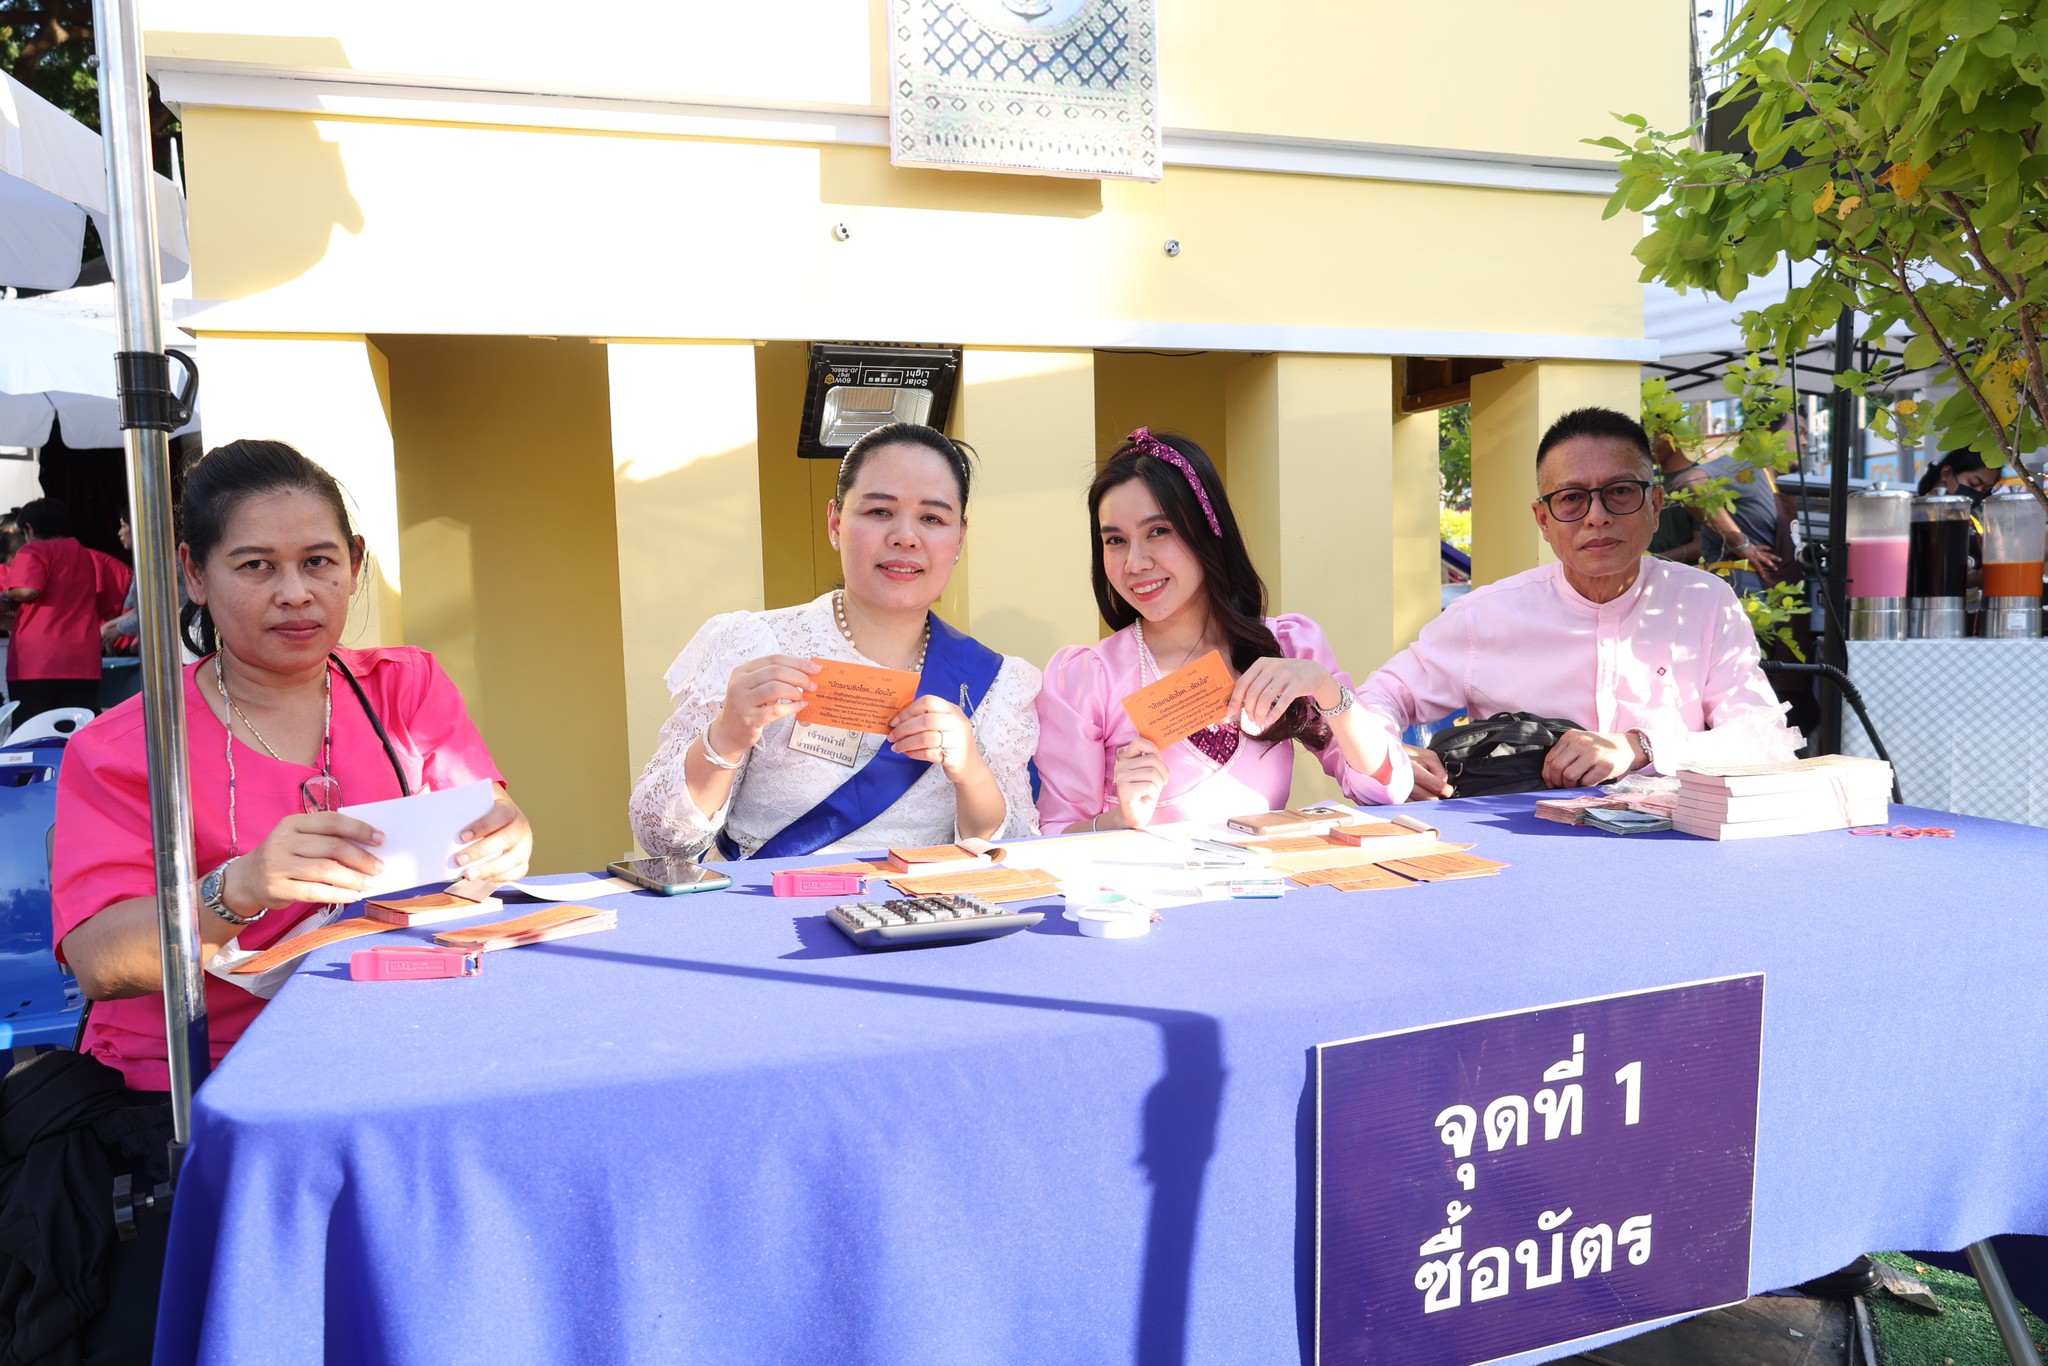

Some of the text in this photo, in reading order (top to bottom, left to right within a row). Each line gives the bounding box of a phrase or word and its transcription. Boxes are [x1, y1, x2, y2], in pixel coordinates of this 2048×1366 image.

[905, 378, 929, 387] Solar
[906, 369, 930, 378] Light
[1434, 1032, 1642, 1191] จุดที่ 1
[1413, 1200, 1653, 1314] ซื้อบัตร
